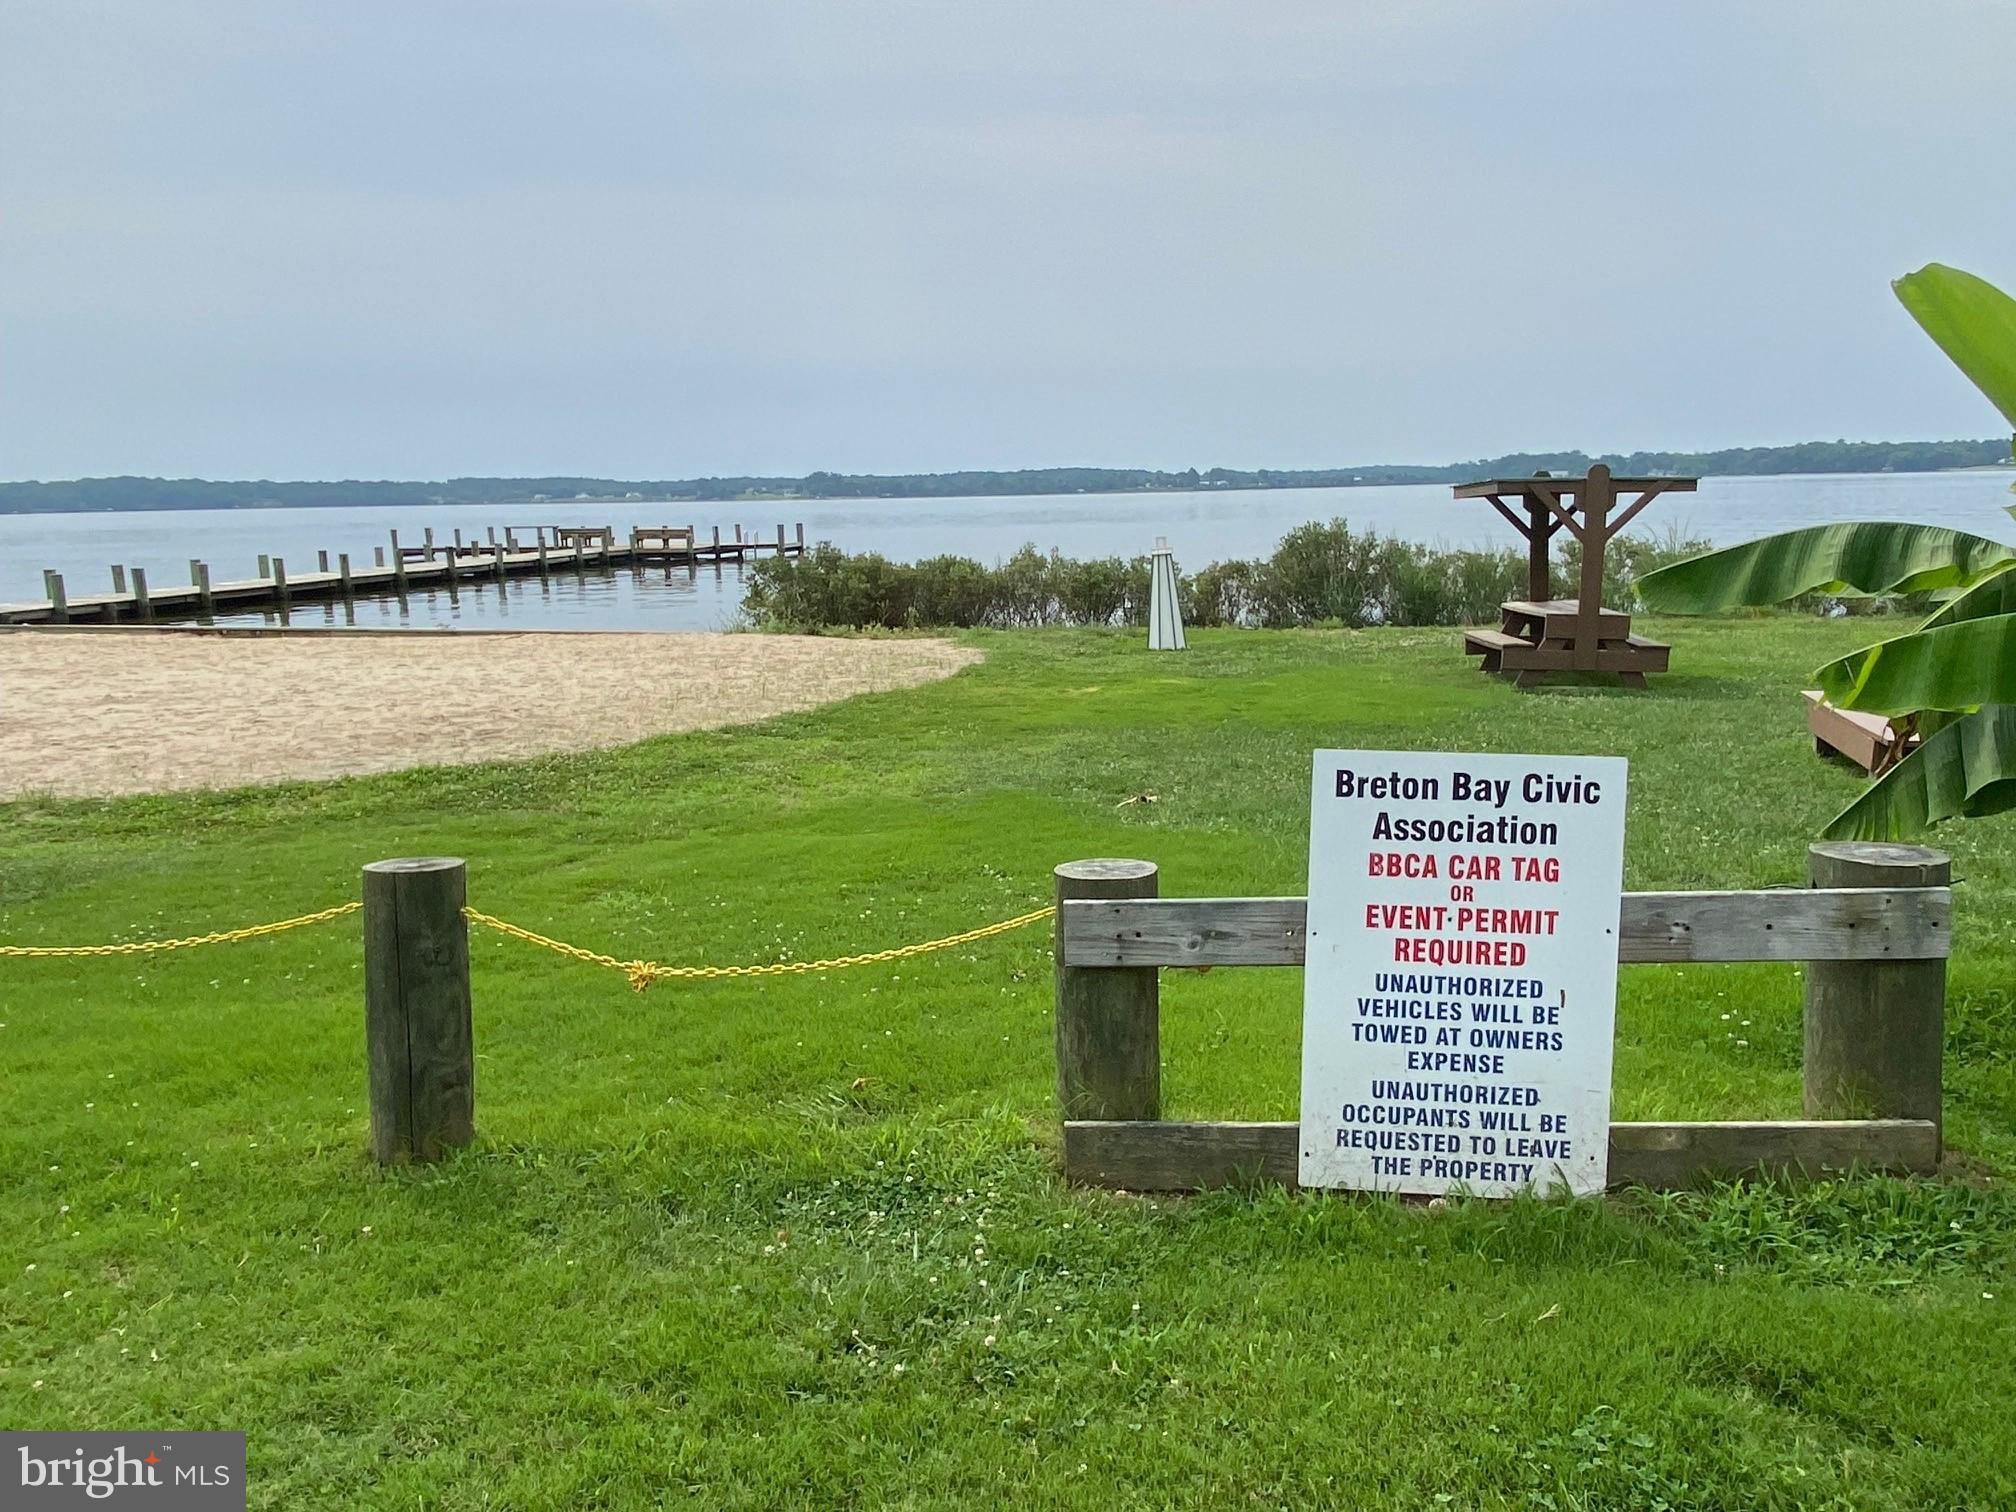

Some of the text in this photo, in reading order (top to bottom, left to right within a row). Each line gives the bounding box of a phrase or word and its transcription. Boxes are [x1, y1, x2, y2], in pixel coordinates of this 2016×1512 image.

[1335, 769, 1601, 808] Breton Bay Civic
[1373, 812, 1558, 845] Association
[1369, 852, 1560, 883] BBCA CAR TAG
[1451, 885, 1474, 902] OR
[1366, 904, 1559, 935] EVENT PERMIT
[1395, 938, 1526, 967] REQUIRED
[1375, 973, 1544, 999] UNAUTHORIZED
[1357, 998, 1559, 1025] VEHICLES WILL BE
[1352, 1023, 1563, 1051] TOWED AT OWNERS
[1408, 1051, 1504, 1074] EXPENSE
[1372, 1080, 1539, 1106] UNAUTHORIZED
[1343, 1104, 1567, 1134] OCCUPANTS WILL BE
[1336, 1129, 1571, 1159] REQUESTED TO LEAVE
[1371, 1155, 1534, 1183] THE PROPERTY
